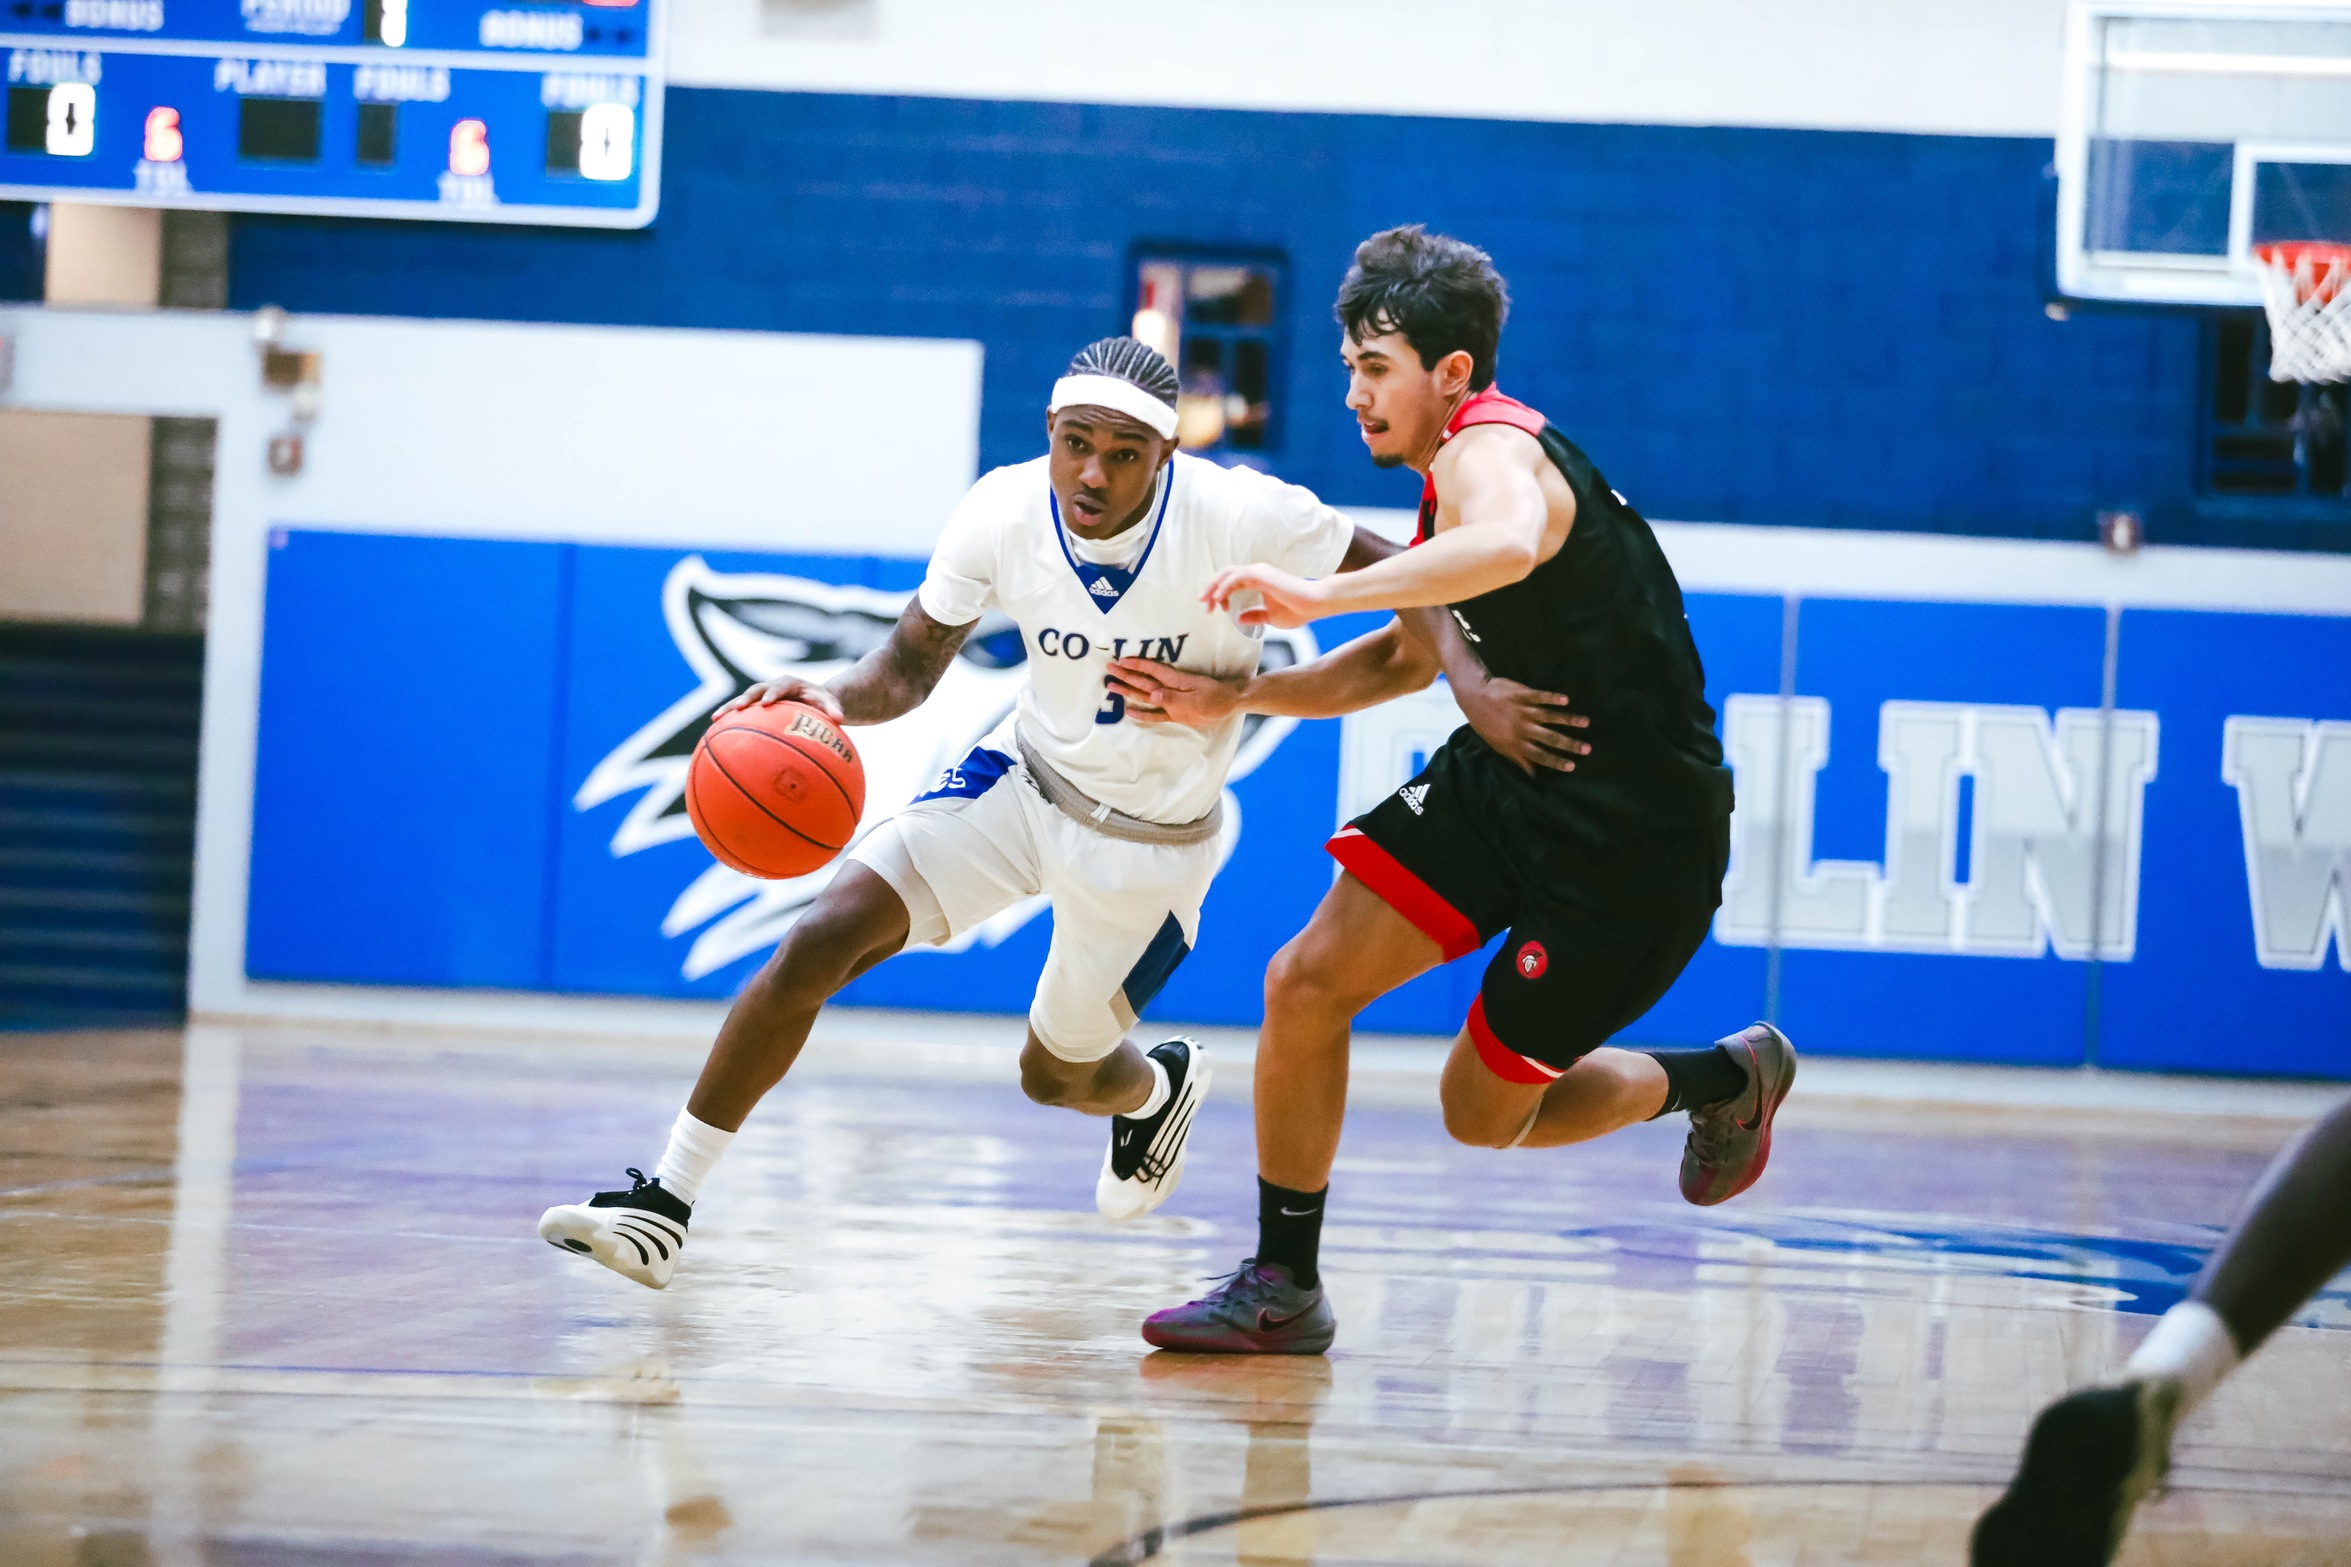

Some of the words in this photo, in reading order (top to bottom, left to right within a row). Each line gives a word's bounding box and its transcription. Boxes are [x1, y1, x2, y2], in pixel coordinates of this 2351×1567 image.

[8, 50, 102, 84] FOULS
[214, 58, 327, 96] PLAYER
[353, 65, 450, 102] FOULS
[541, 73, 640, 108] FOULS
[46, 82, 96, 156] 0
[144, 106, 183, 162] 6
[450, 119, 490, 176] 6
[1399, 787, 1424, 815] adidas
